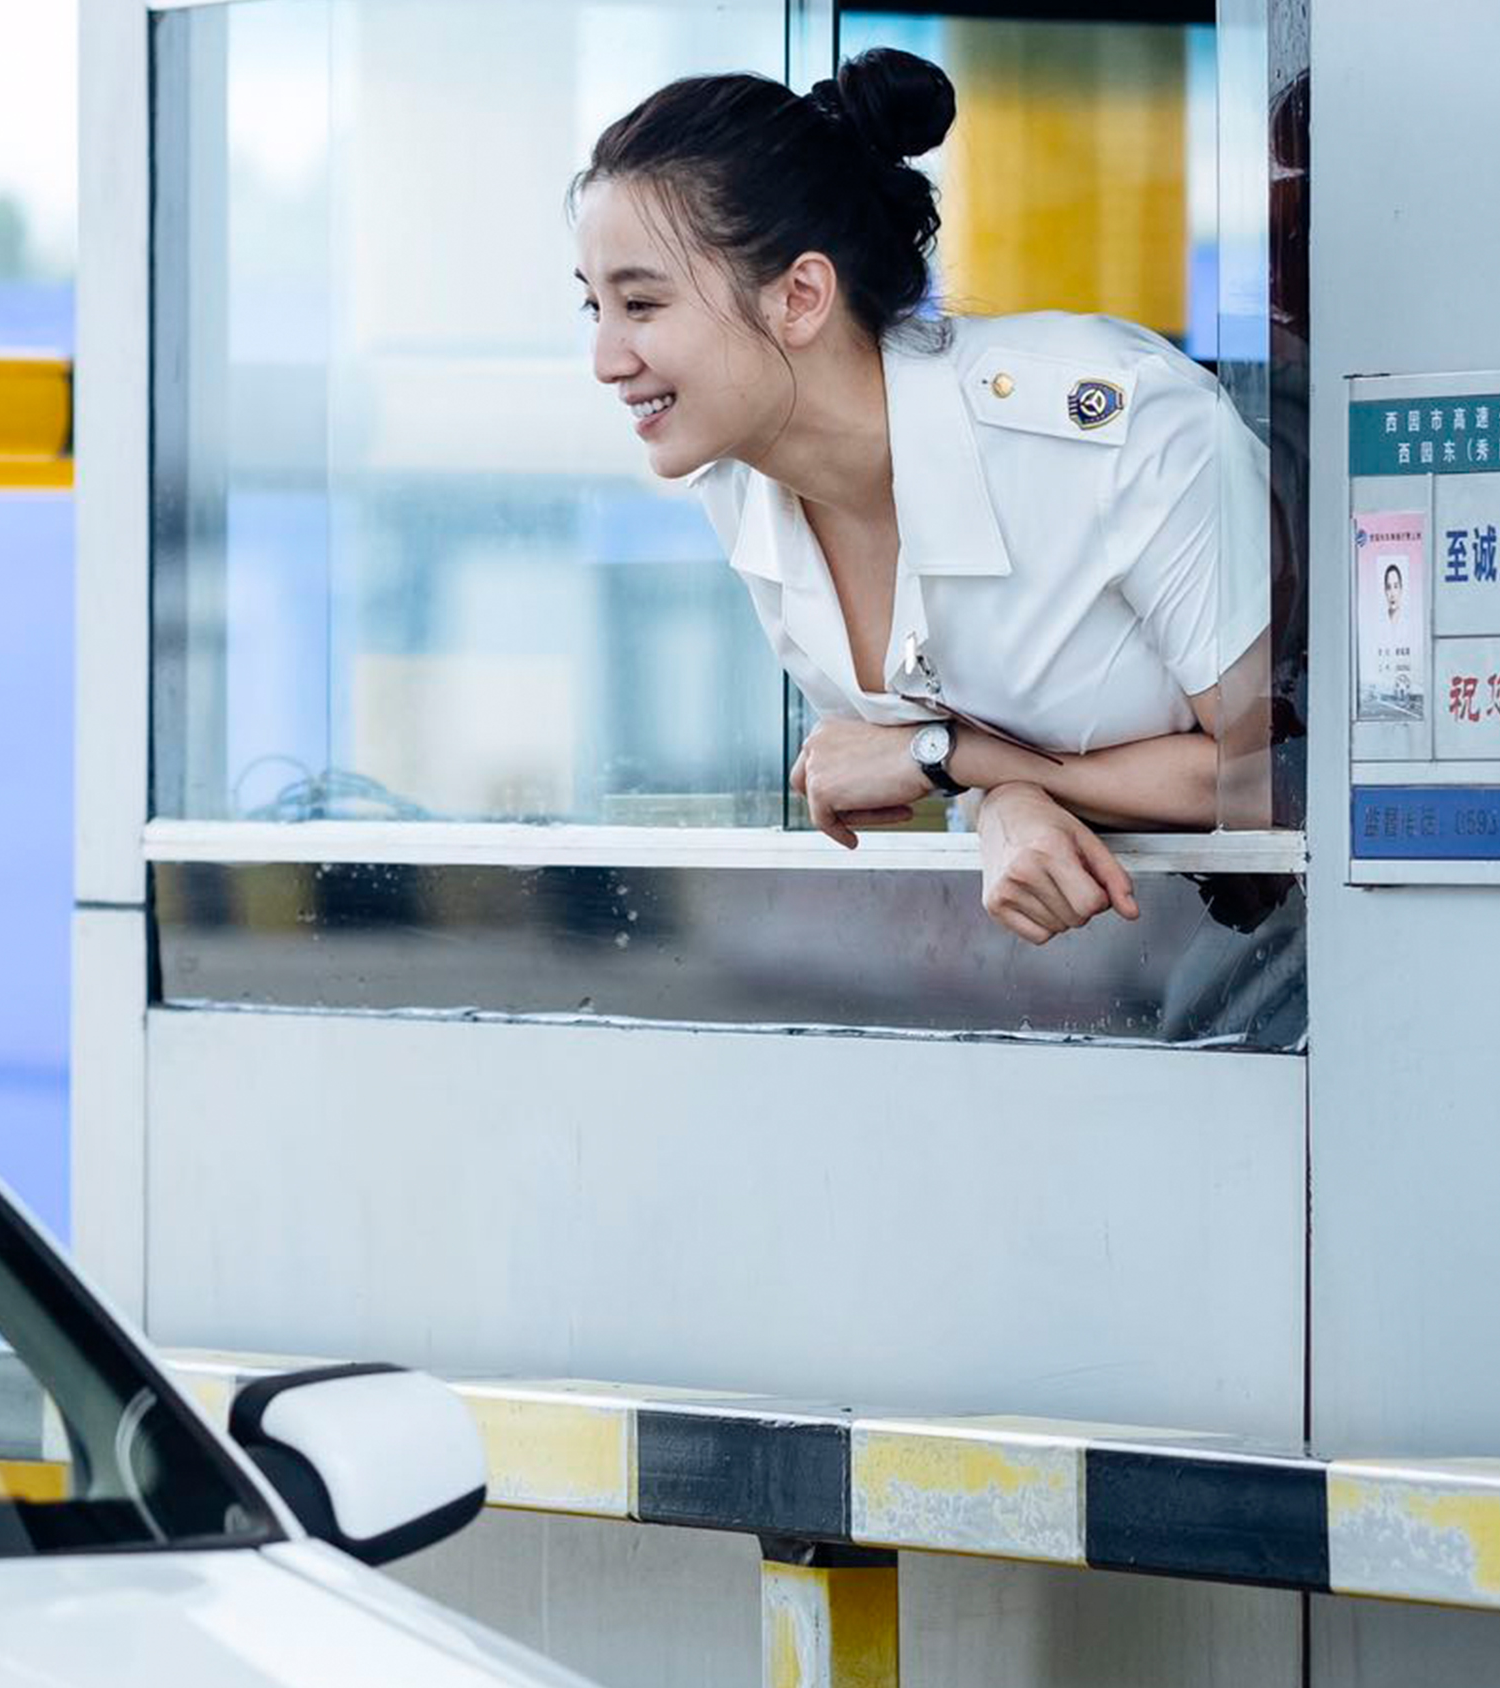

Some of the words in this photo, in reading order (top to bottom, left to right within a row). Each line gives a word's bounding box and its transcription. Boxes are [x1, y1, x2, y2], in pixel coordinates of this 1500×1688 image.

[1384, 406, 1500, 433] 西园市高速
[1444, 524, 1498, 583] 至诚
